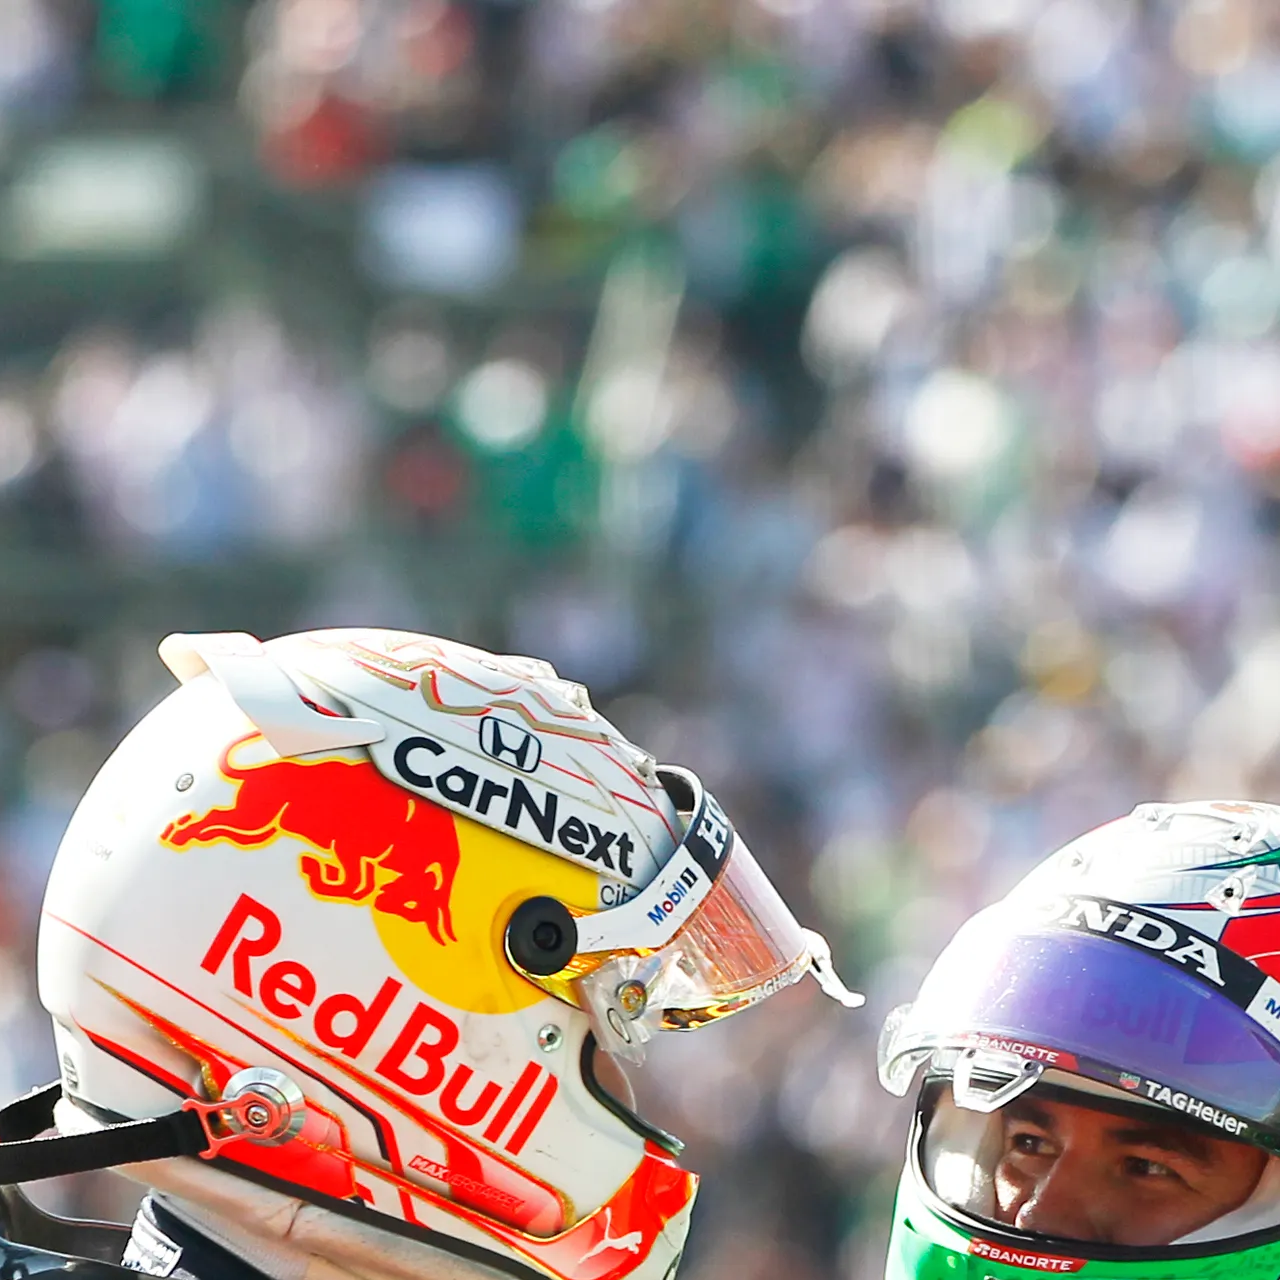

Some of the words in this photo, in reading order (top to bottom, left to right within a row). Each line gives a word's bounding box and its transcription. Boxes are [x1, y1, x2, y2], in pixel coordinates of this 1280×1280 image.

[393, 736, 634, 878] CarNext
[647, 880, 688, 926] Mobil
[1042, 896, 1226, 987] NDA
[980, 1036, 1059, 1064] BANORTE
[410, 1155, 449, 1181] MAX
[989, 1247, 1074, 1271] BANORTE
